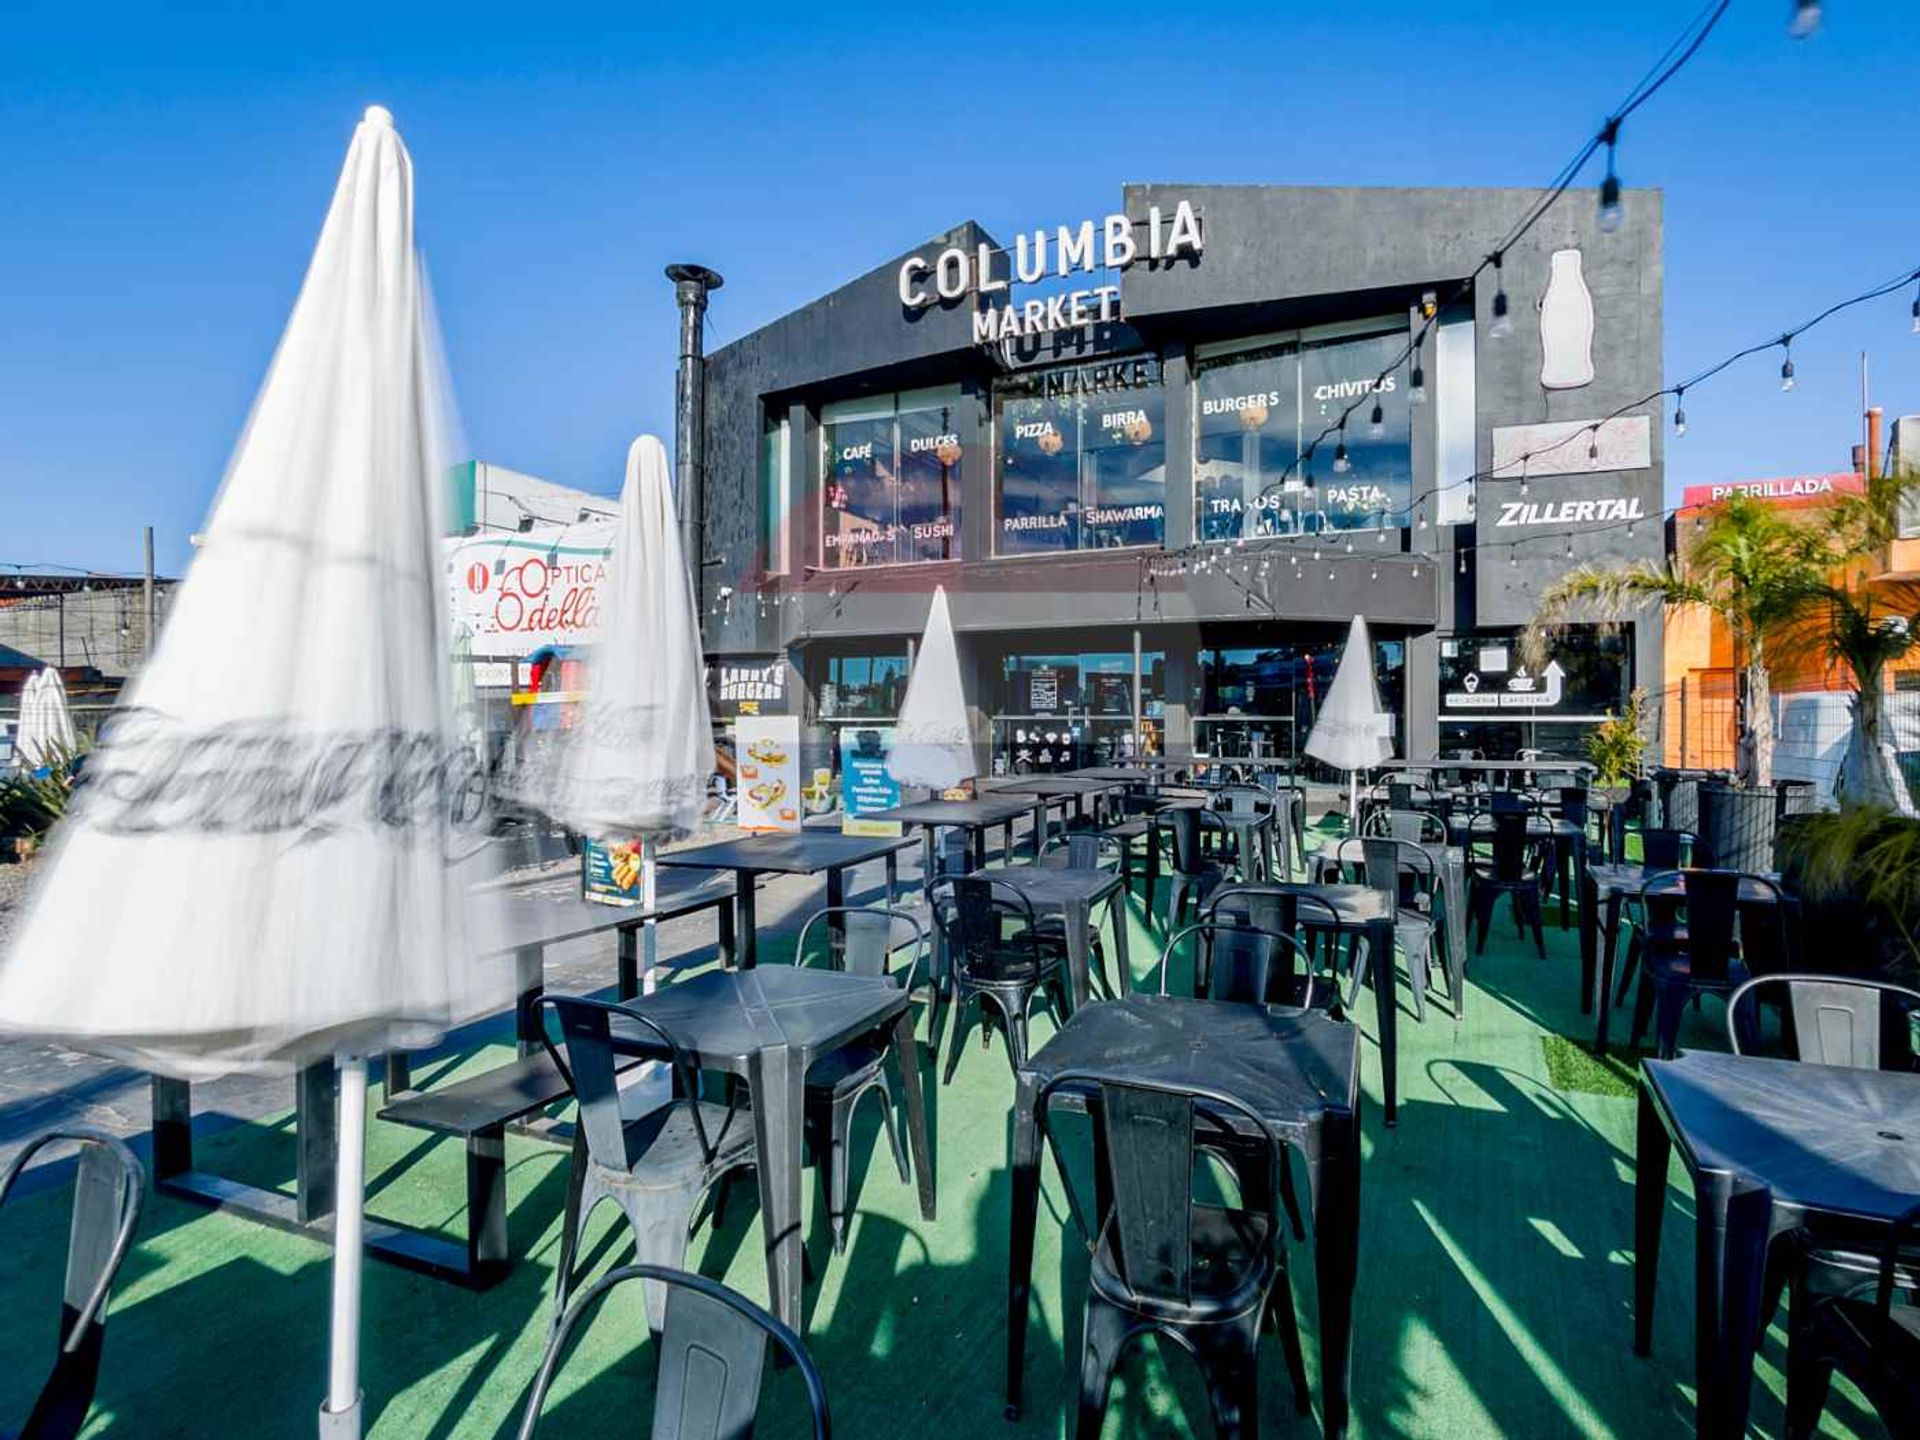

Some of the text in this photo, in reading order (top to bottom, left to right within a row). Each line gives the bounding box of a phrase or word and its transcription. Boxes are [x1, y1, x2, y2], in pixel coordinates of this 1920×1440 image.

[898, 200, 1204, 307] COLUMBIA
[972, 285, 1119, 343] MARKET
[1315, 377, 1396, 400] CHIVITOS
[1202, 391, 1280, 415] BURGERS
[1102, 410, 1147, 428] BIRRA
[1015, 421, 1053, 439] PIZZA
[911, 433, 958, 452] DULCES
[1711, 477, 1834, 501] PARRILLADA
[1004, 512, 1068, 531] PARRILLA
[1086, 504, 1164, 524] SHAWARMA
[1496, 498, 1644, 527] ZILLERTAL
[914, 522, 955, 539] SUSHI
